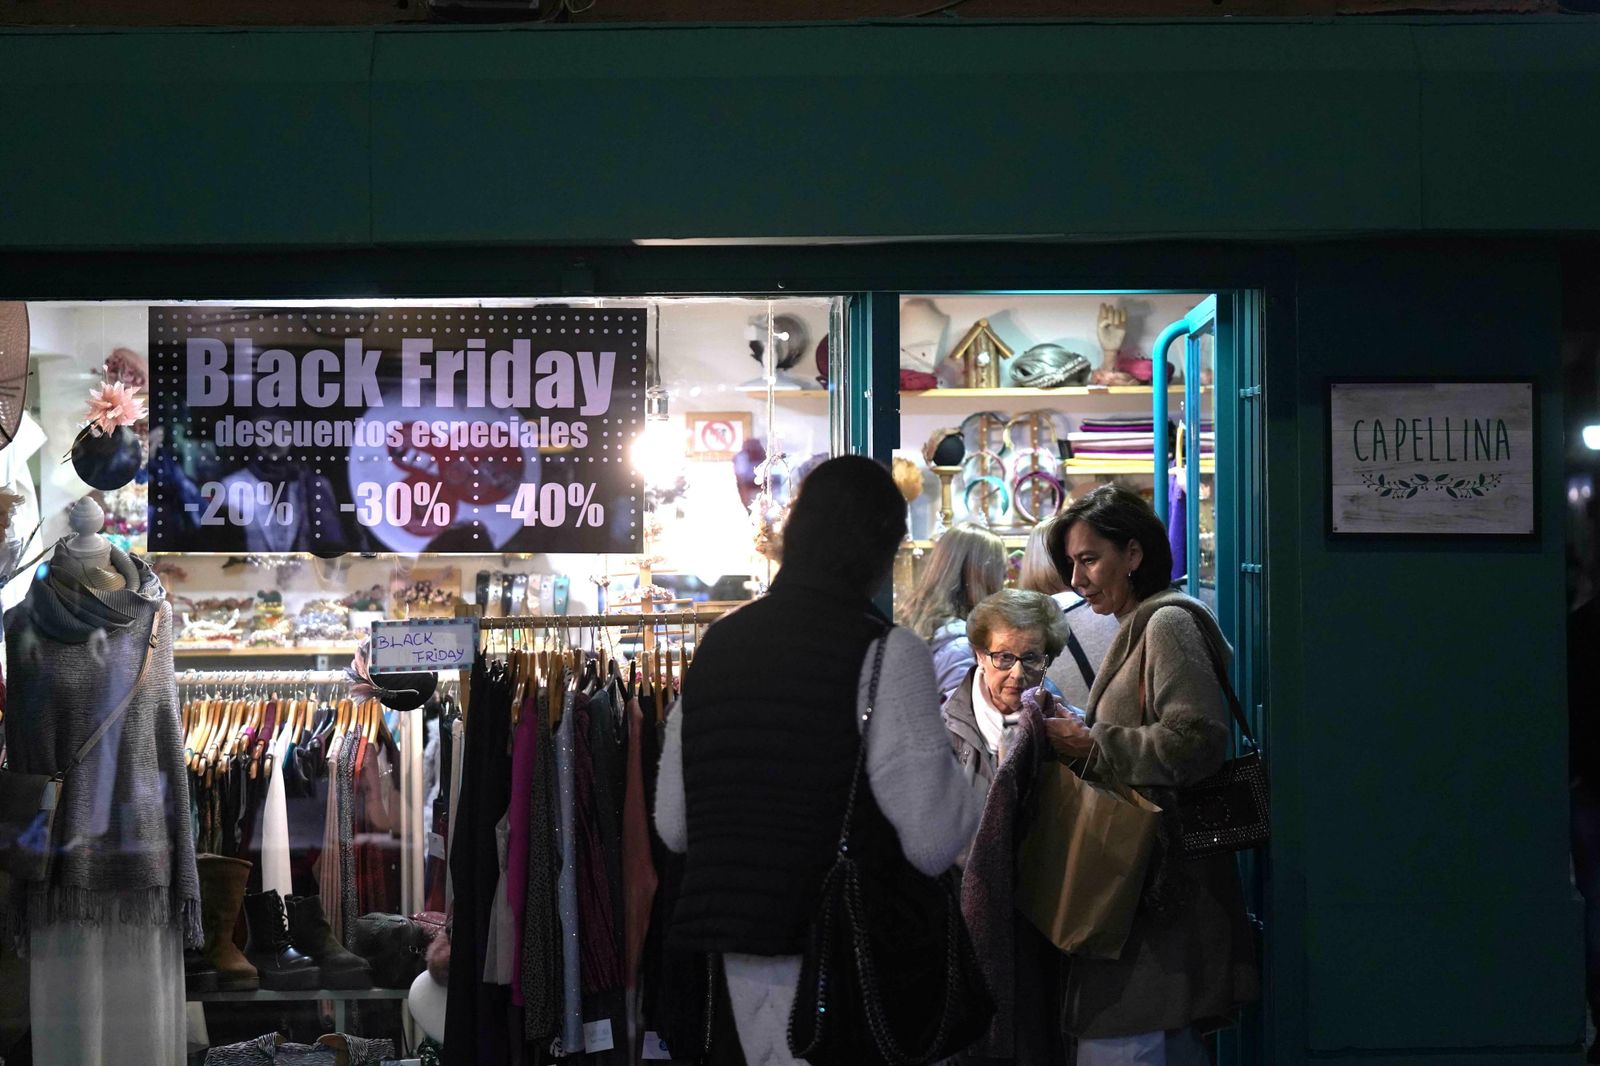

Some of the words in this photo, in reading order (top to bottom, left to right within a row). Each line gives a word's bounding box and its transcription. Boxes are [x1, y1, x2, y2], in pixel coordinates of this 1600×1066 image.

[186, 337, 384, 408] Black
[401, 337, 616, 416] Friday
[215, 415, 403, 449] descuentos
[411, 416, 589, 452] especiales
[1353, 417, 1510, 462] CAPELLINA
[184, 481, 294, 527] -20%
[340, 481, 450, 528] -30%
[495, 482, 604, 528] -40%
[377, 632, 434, 649] BLACK
